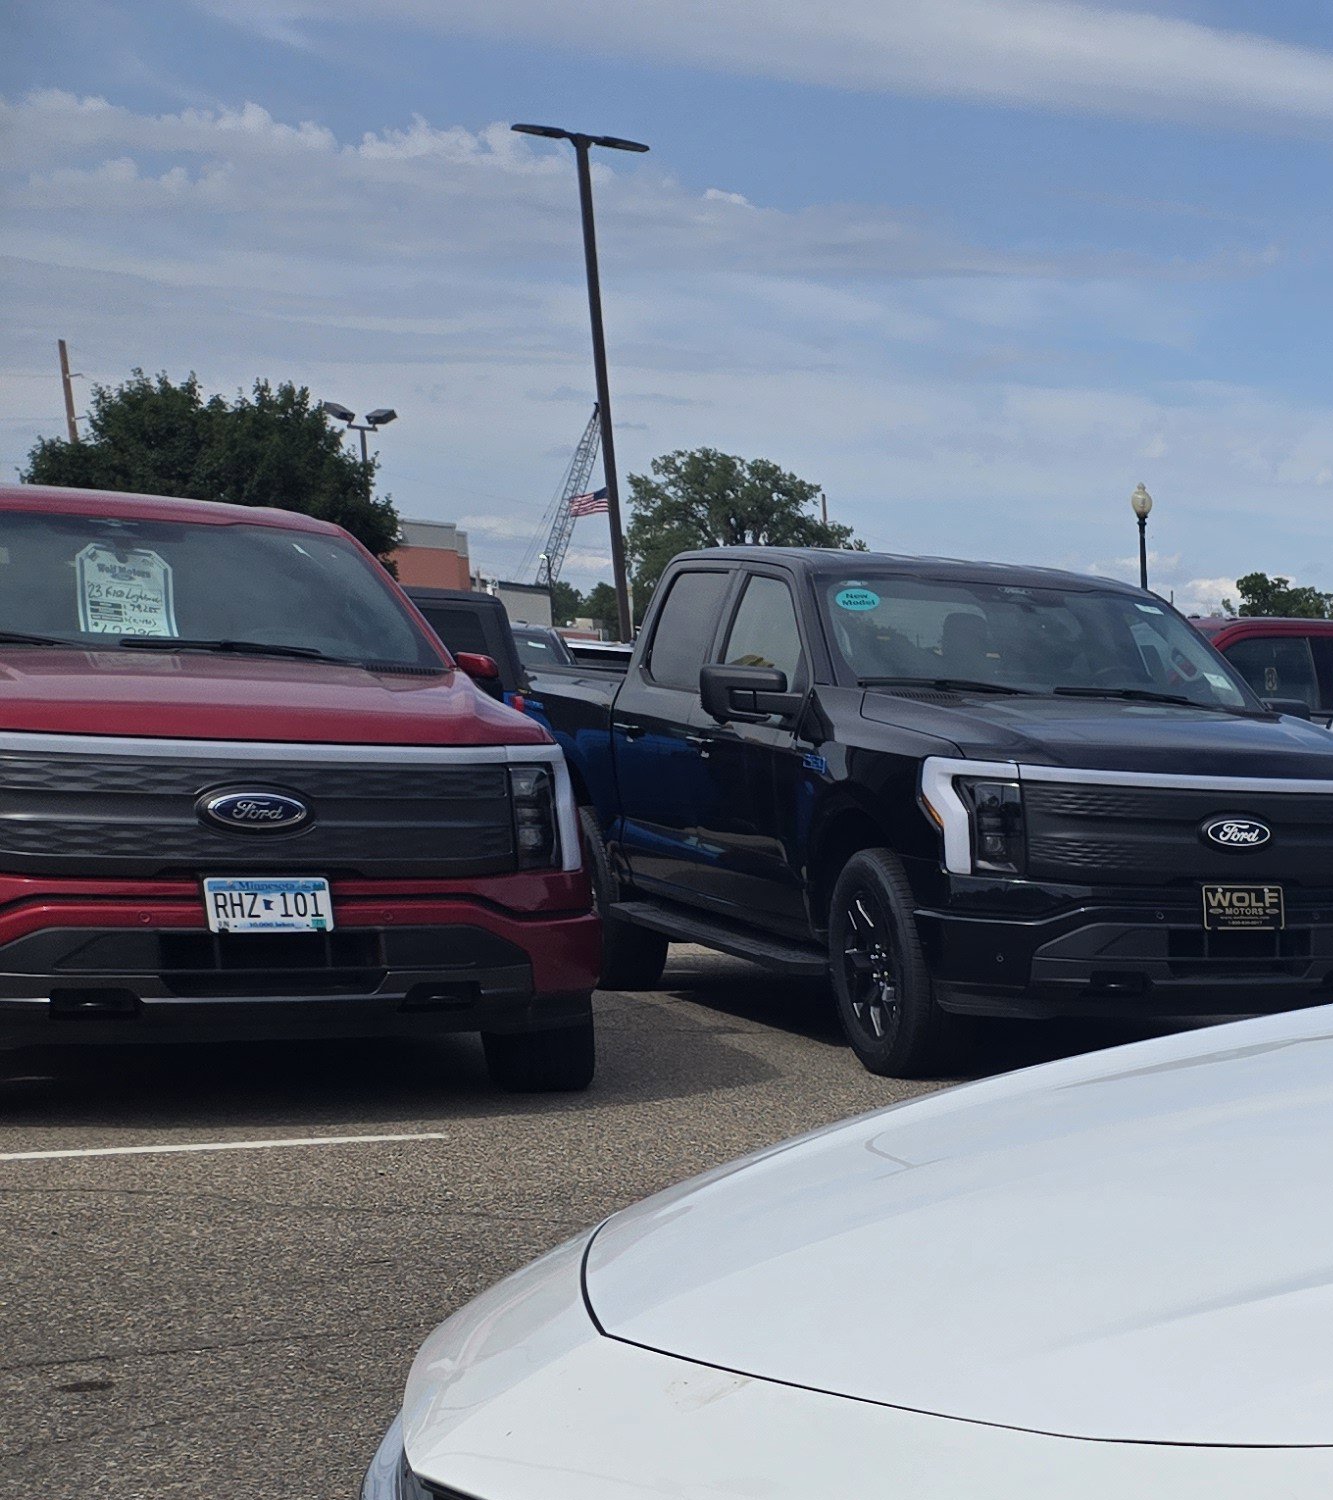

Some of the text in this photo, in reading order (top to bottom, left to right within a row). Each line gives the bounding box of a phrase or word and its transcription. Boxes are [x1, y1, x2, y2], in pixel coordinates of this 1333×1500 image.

[232, 800, 284, 820] Ford
[1219, 823, 1260, 842] Ford
[238, 881, 295, 890] Minnesota
[213, 892, 325, 919] RHZ 101
[1207, 891, 1279, 907] WOLF
[1225, 907, 1264, 915] MOTORS
